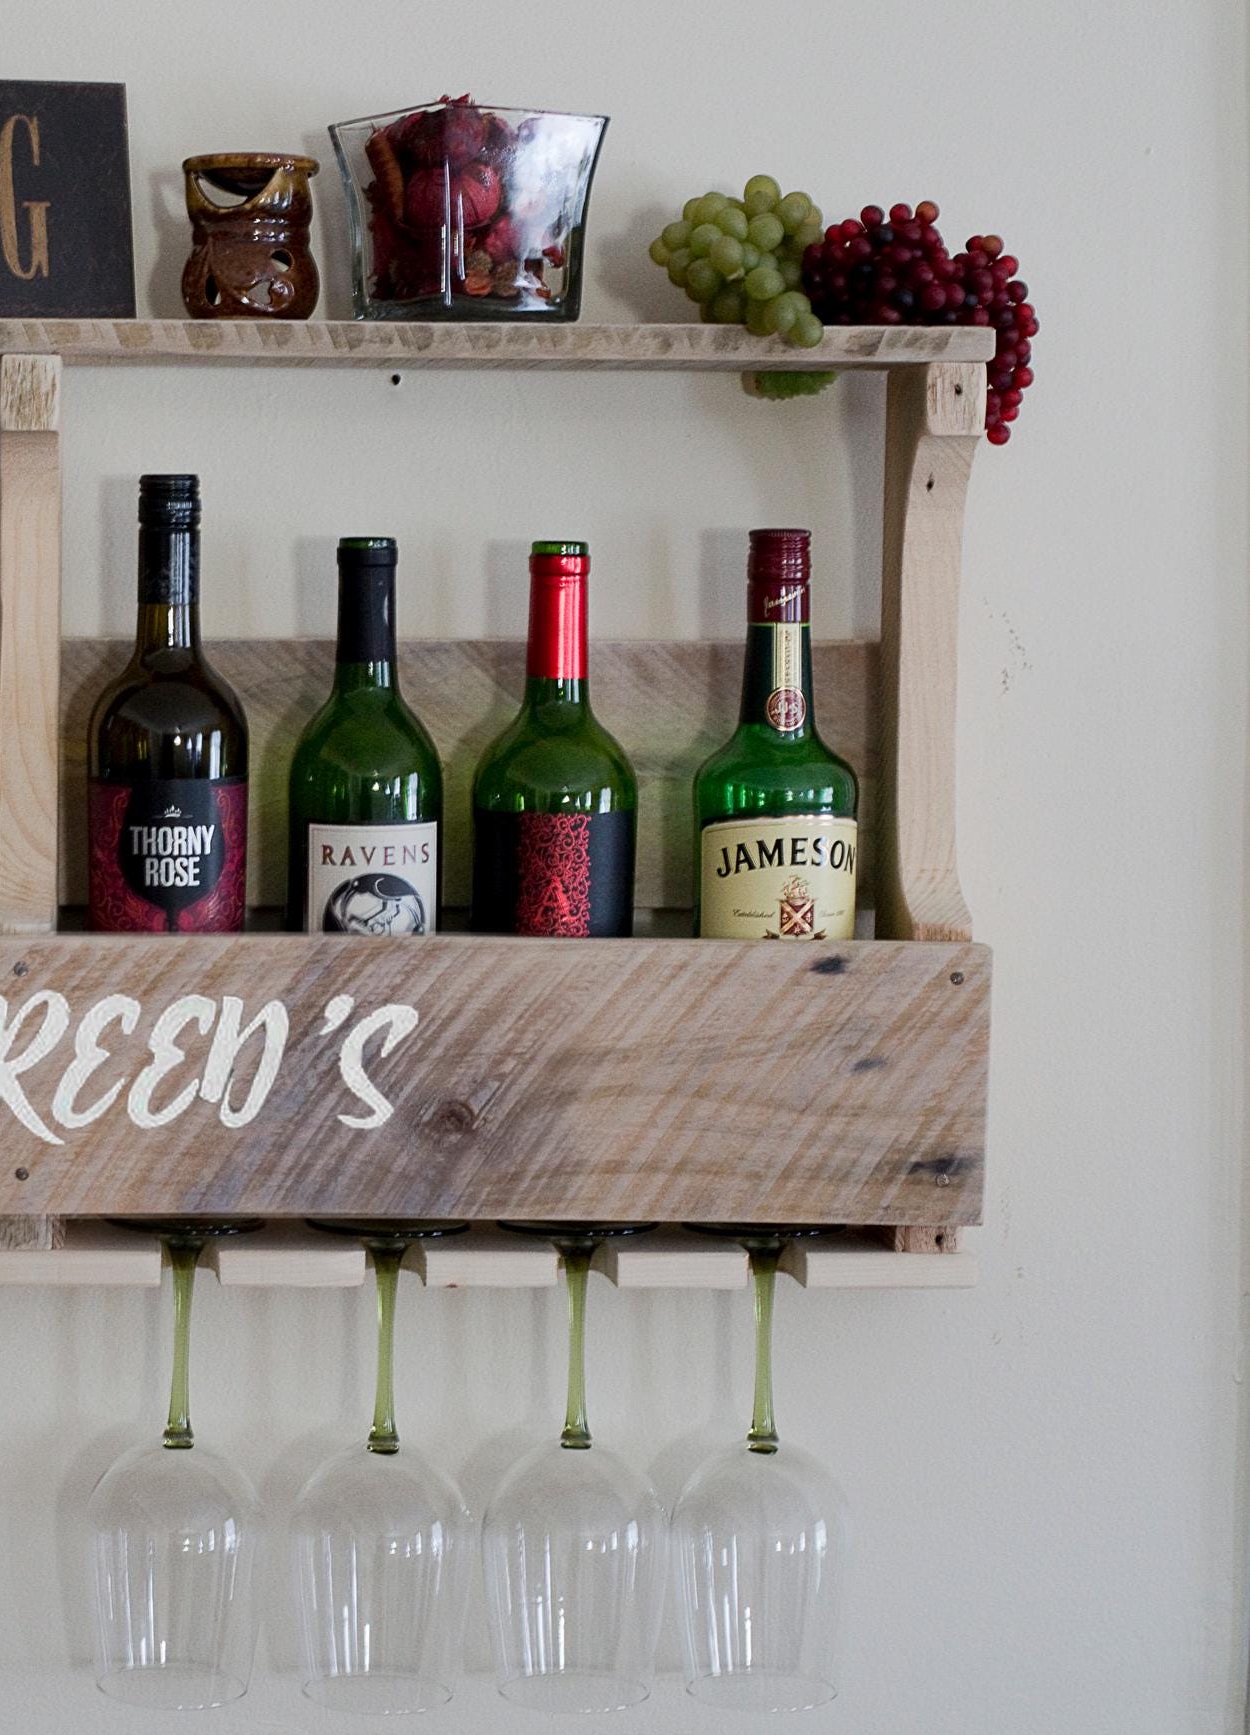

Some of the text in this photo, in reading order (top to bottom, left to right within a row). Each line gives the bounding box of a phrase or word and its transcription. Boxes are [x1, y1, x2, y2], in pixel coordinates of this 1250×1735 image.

[129, 825, 215, 856] THORNY
[321, 842, 430, 866] RAVENS
[144, 857, 201, 887] ROSE
[716, 836, 856, 878] JAMESON
